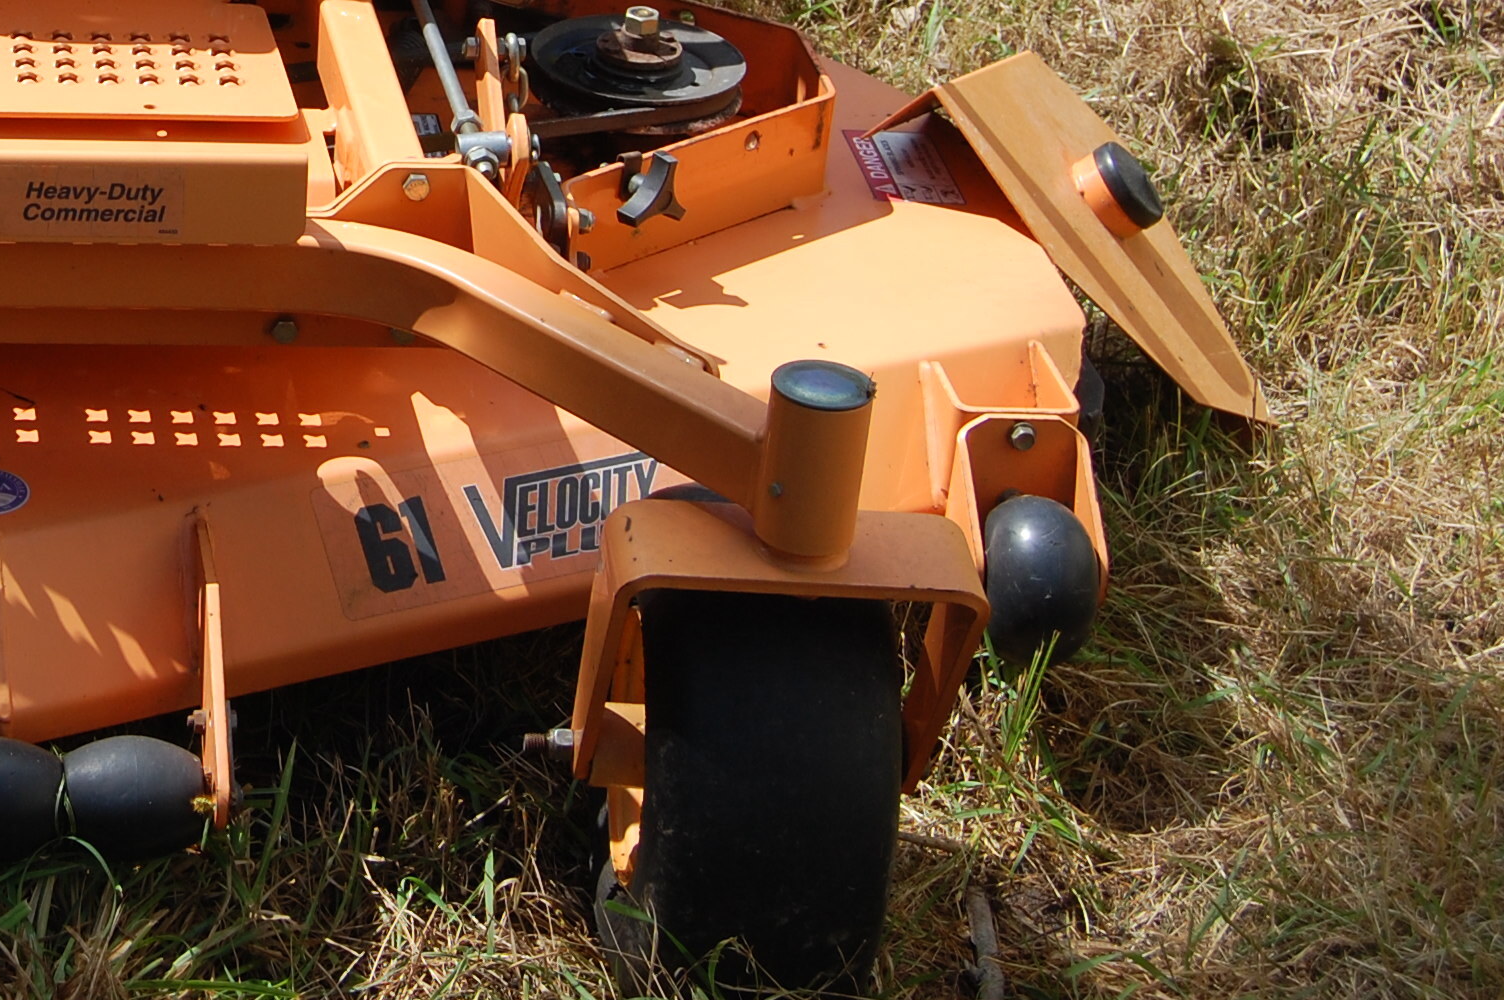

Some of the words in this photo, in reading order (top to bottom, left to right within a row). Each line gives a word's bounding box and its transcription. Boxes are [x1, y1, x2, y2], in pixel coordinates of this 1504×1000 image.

[26, 181, 164, 204] Heavy-Duty
[23, 202, 166, 223] Commercial
[462, 450, 660, 571] VELOCITY
[354, 495, 446, 593] 61
[516, 529, 603, 567] PLU
